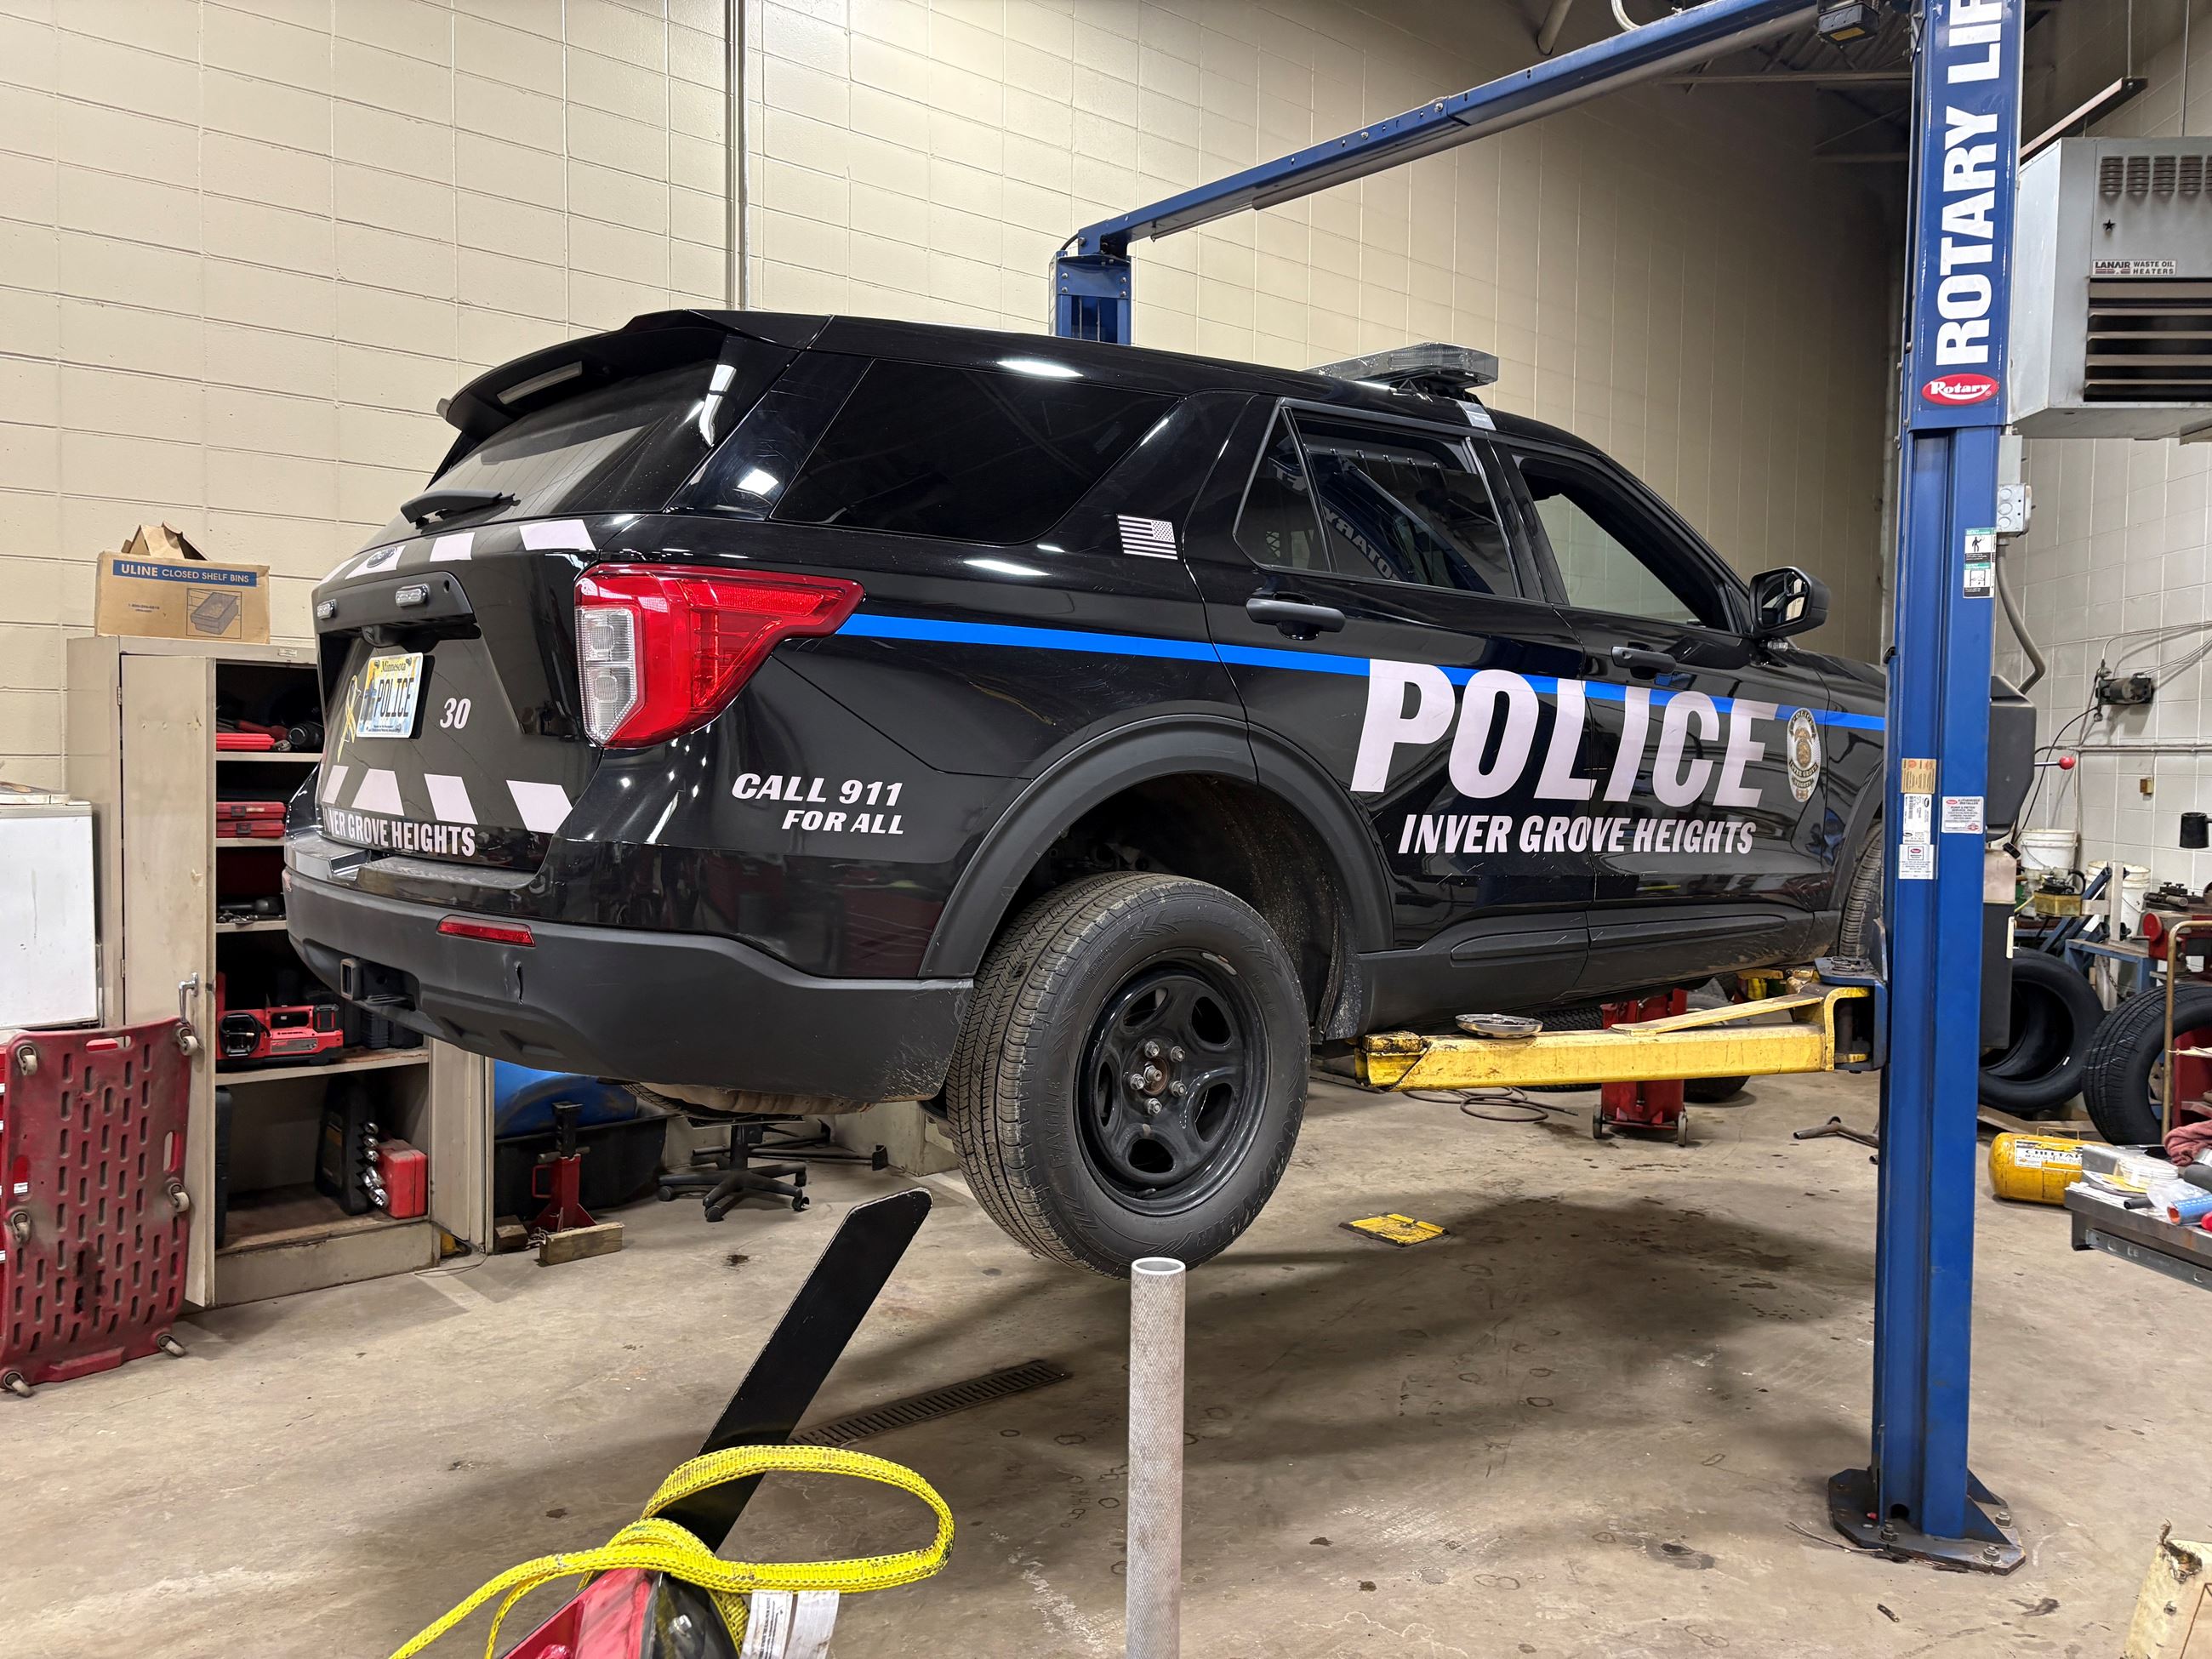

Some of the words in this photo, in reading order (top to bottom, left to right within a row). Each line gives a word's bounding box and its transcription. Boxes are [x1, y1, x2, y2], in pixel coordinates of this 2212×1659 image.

[1947, 0, 2003, 84] LIF
[1936, 105, 1998, 366] ROTARY
[1930, 380, 1992, 400] Rotary
[121, 563, 158, 577] ULINE
[162, 568, 200, 579] CLOSED
[202, 572, 228, 582] SHELF
[230, 574, 249, 583] BINS
[381, 660, 407, 673] Minnesota
[374, 677, 414, 718] POLICE
[439, 698, 471, 729] 30
[1350, 658, 1778, 807] POLICE
[732, 772, 827, 803] CALL
[839, 779, 904, 807] 911
[348, 813, 390, 847] GROVE
[391, 821, 476, 857] HEIGHTS
[781, 809, 847, 832] FOR
[850, 812, 904, 835] ALL
[1398, 814, 1513, 853] INVER
[1519, 815, 1631, 853] GROVE
[1633, 818, 1757, 854] HEIGHTS
